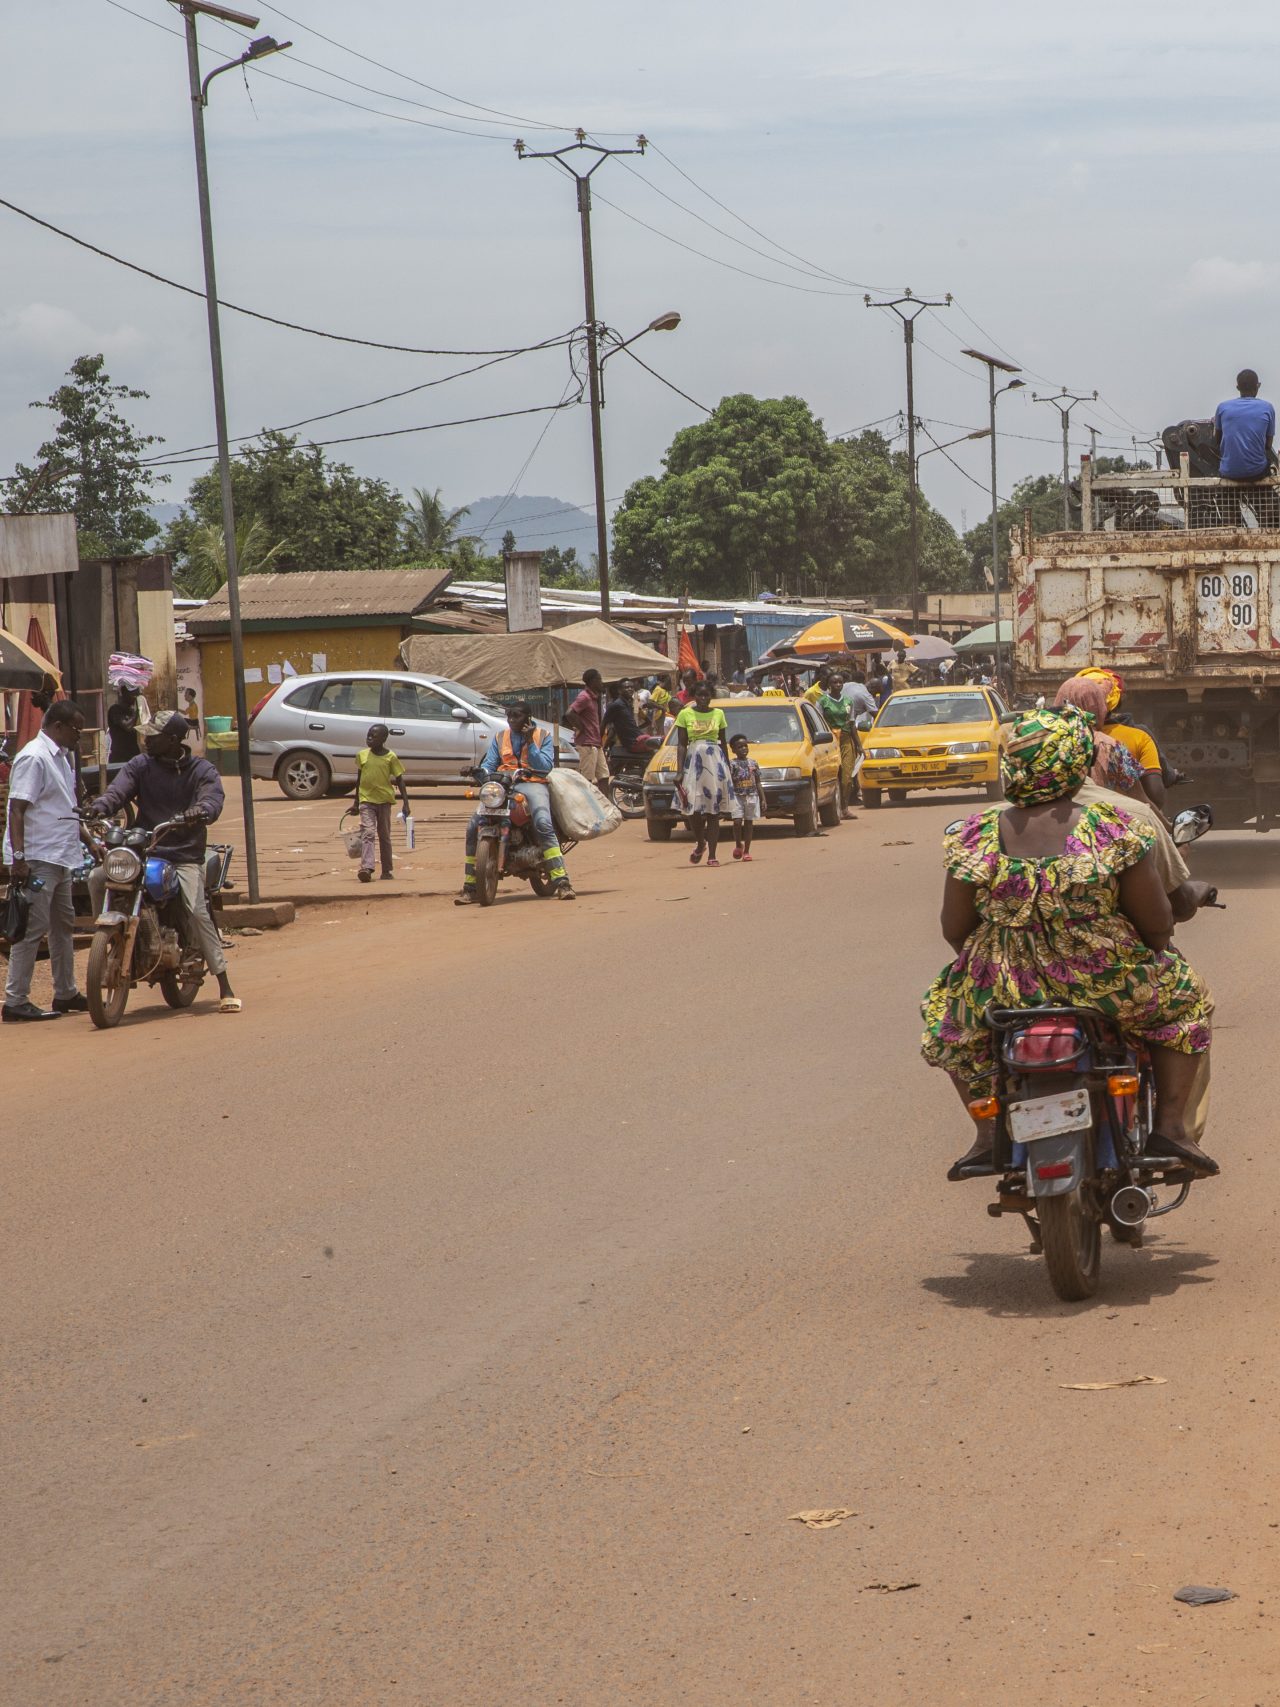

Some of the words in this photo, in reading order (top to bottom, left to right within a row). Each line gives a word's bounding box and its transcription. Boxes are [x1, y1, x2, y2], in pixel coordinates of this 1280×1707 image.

[1201, 576, 1221, 597] 60
[1232, 575, 1252, 596] 80
[1231, 604, 1251, 625] 90
